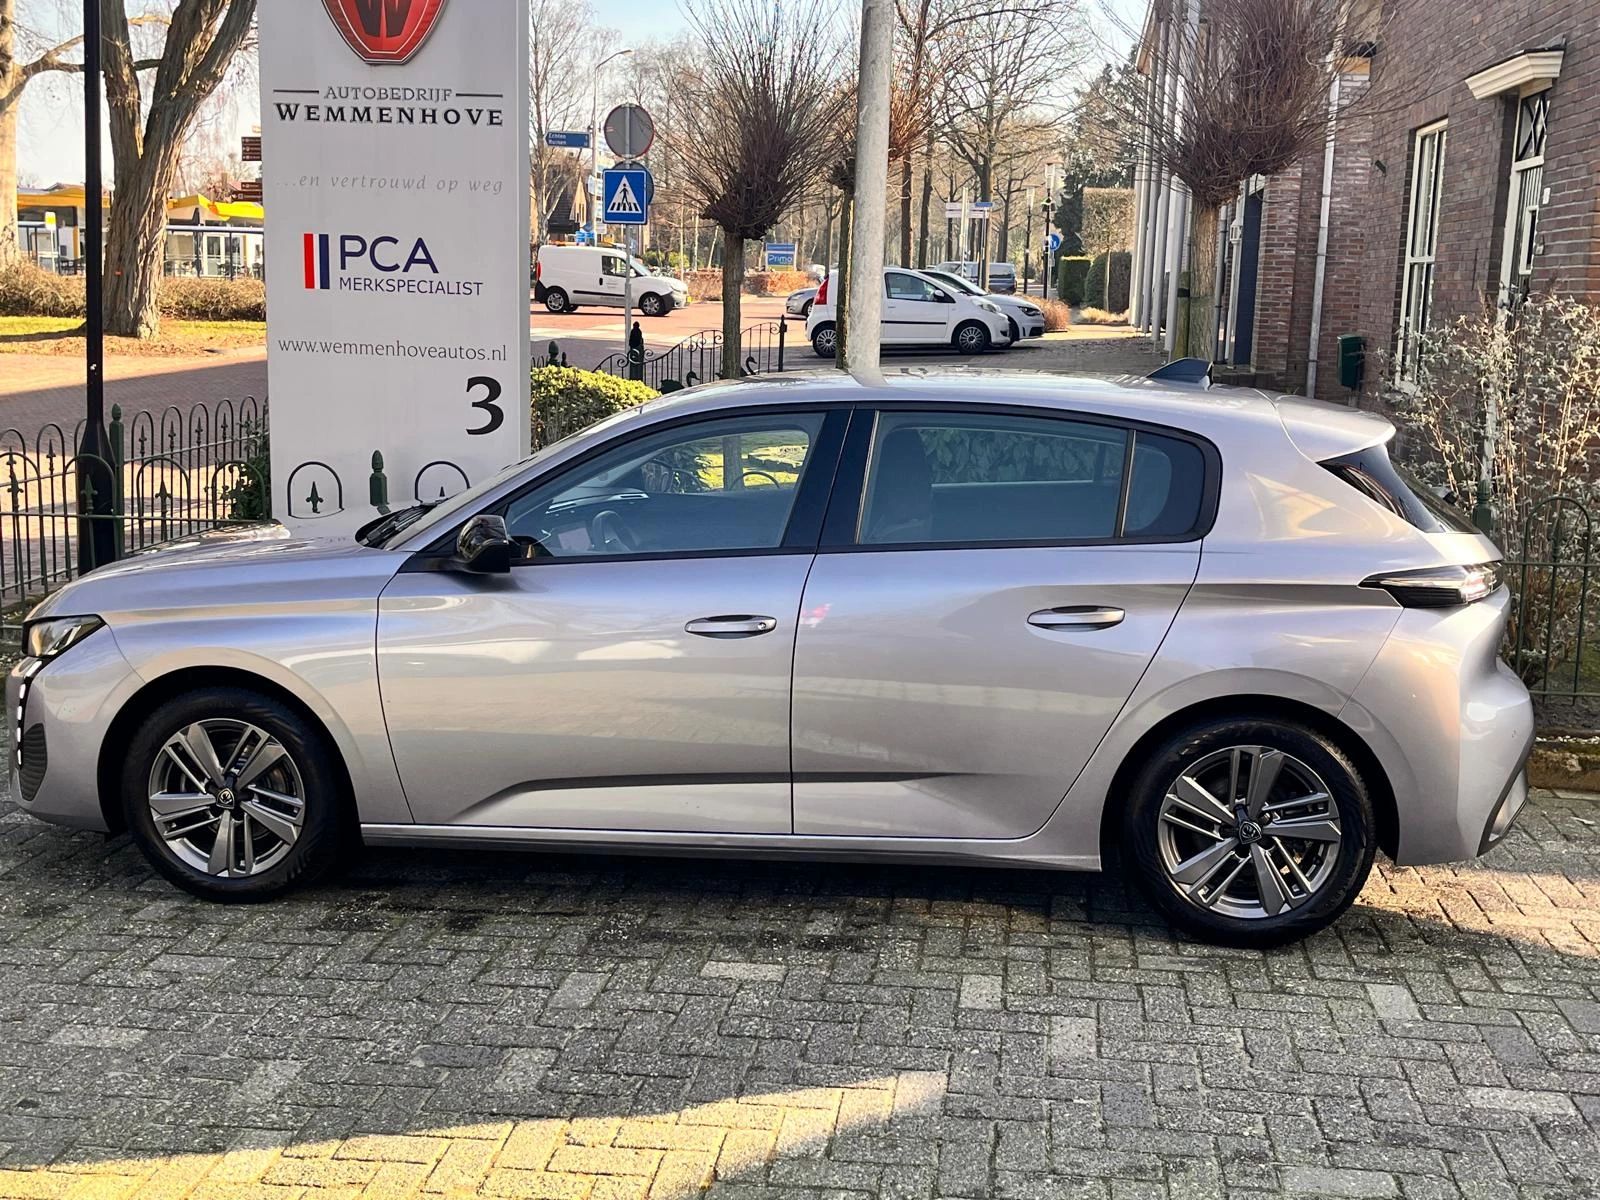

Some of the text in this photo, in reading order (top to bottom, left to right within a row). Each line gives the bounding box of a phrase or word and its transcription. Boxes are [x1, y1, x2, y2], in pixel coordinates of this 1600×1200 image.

[324, 86, 453, 102] AUTOBEDRIJF
[275, 103, 503, 126] WEMMENHOVE
[330, 174, 427, 191] vertrouwd
[436, 180, 459, 194] op
[468, 180, 504, 195] weg
[339, 234, 440, 274] PCA
[339, 277, 484, 296] MERKSPECIALIST
[278, 339, 507, 362] www.wemmenhoveautos.nl
[465, 375, 505, 436] 3
